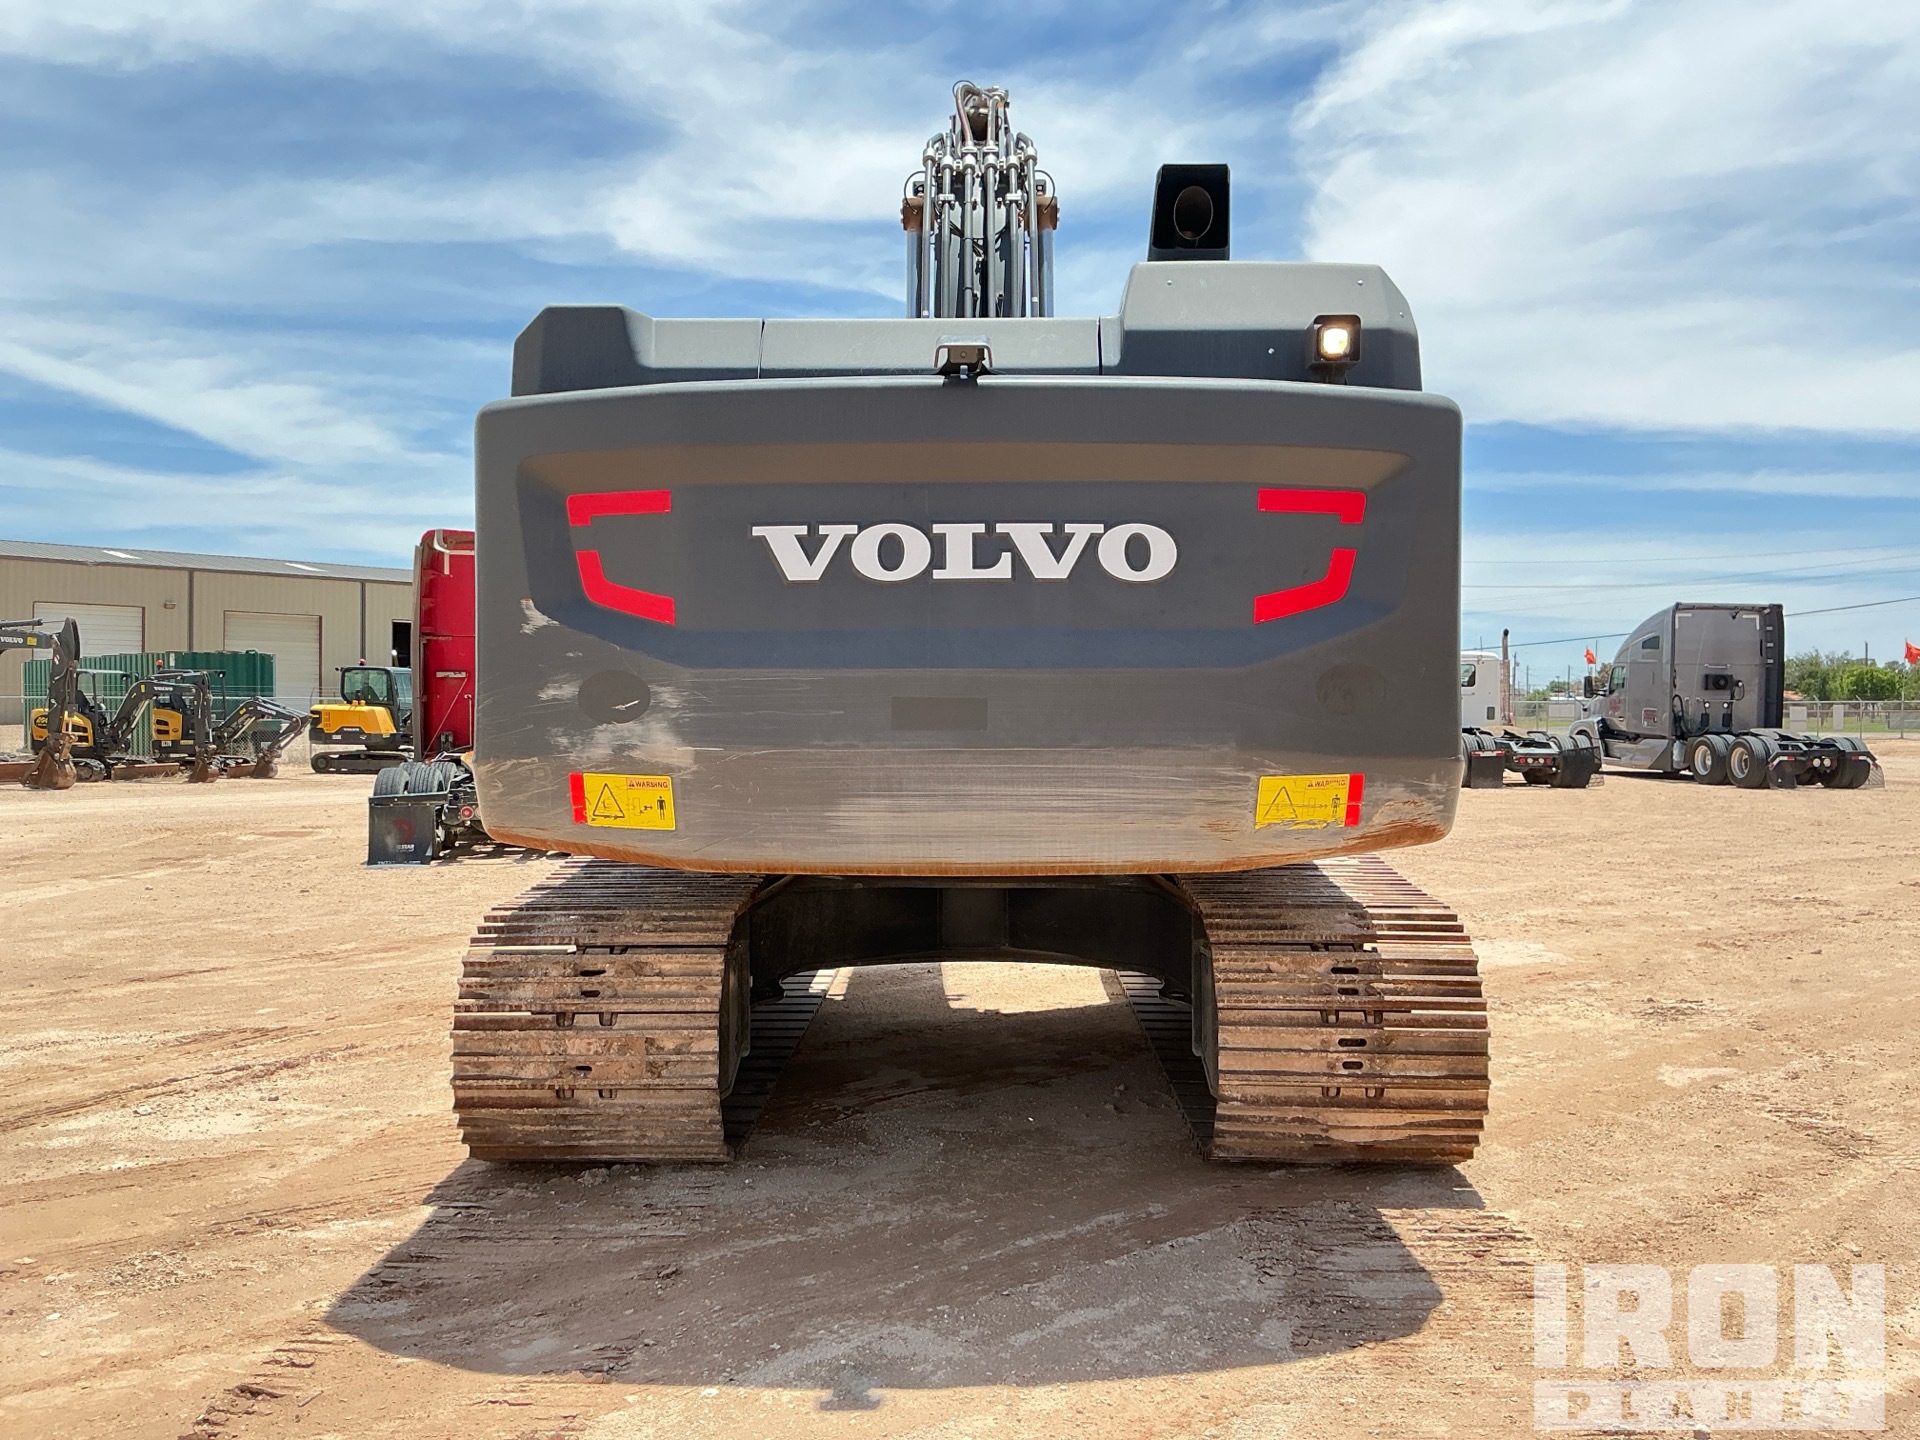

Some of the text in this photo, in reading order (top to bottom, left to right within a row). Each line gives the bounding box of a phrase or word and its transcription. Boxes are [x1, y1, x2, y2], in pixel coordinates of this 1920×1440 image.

[752, 523, 1177, 582] VOLVO
[0, 636, 24, 644] VOLVO
[635, 780, 669, 789] WARNING
